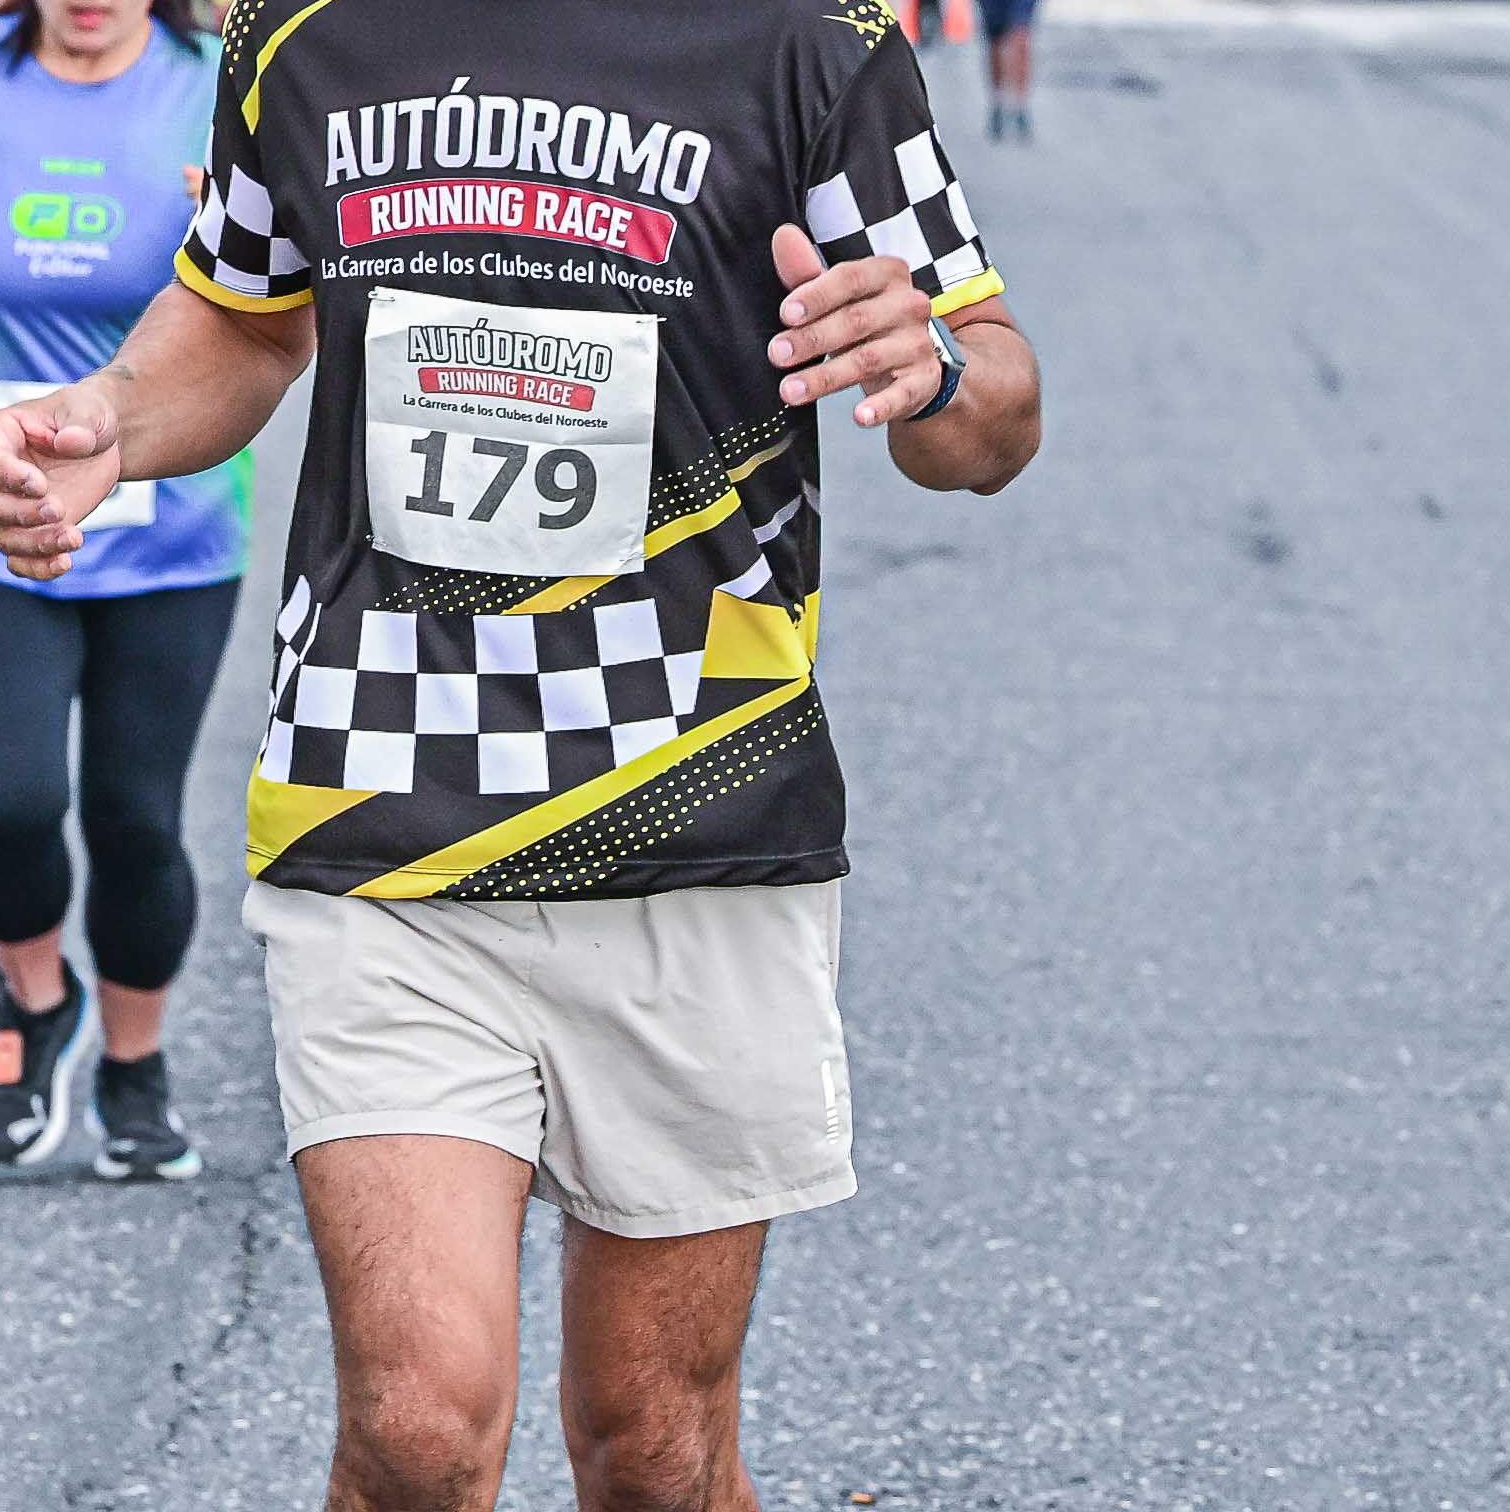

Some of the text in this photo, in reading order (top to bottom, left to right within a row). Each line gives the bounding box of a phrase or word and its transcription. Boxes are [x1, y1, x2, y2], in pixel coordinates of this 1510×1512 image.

[324, 76, 712, 205] AUTÓDROMO
[369, 184, 634, 249] RUNNING RACE
[321, 251, 694, 298] La Carrera de los Clubes del Noroeste
[407, 317, 613, 383] AUTÓDROMO
[403, 394, 608, 429] La Carrera de los Clubes del Noroeste
[437, 370, 574, 406] RUNNING RACE
[404, 430, 598, 531] 179
